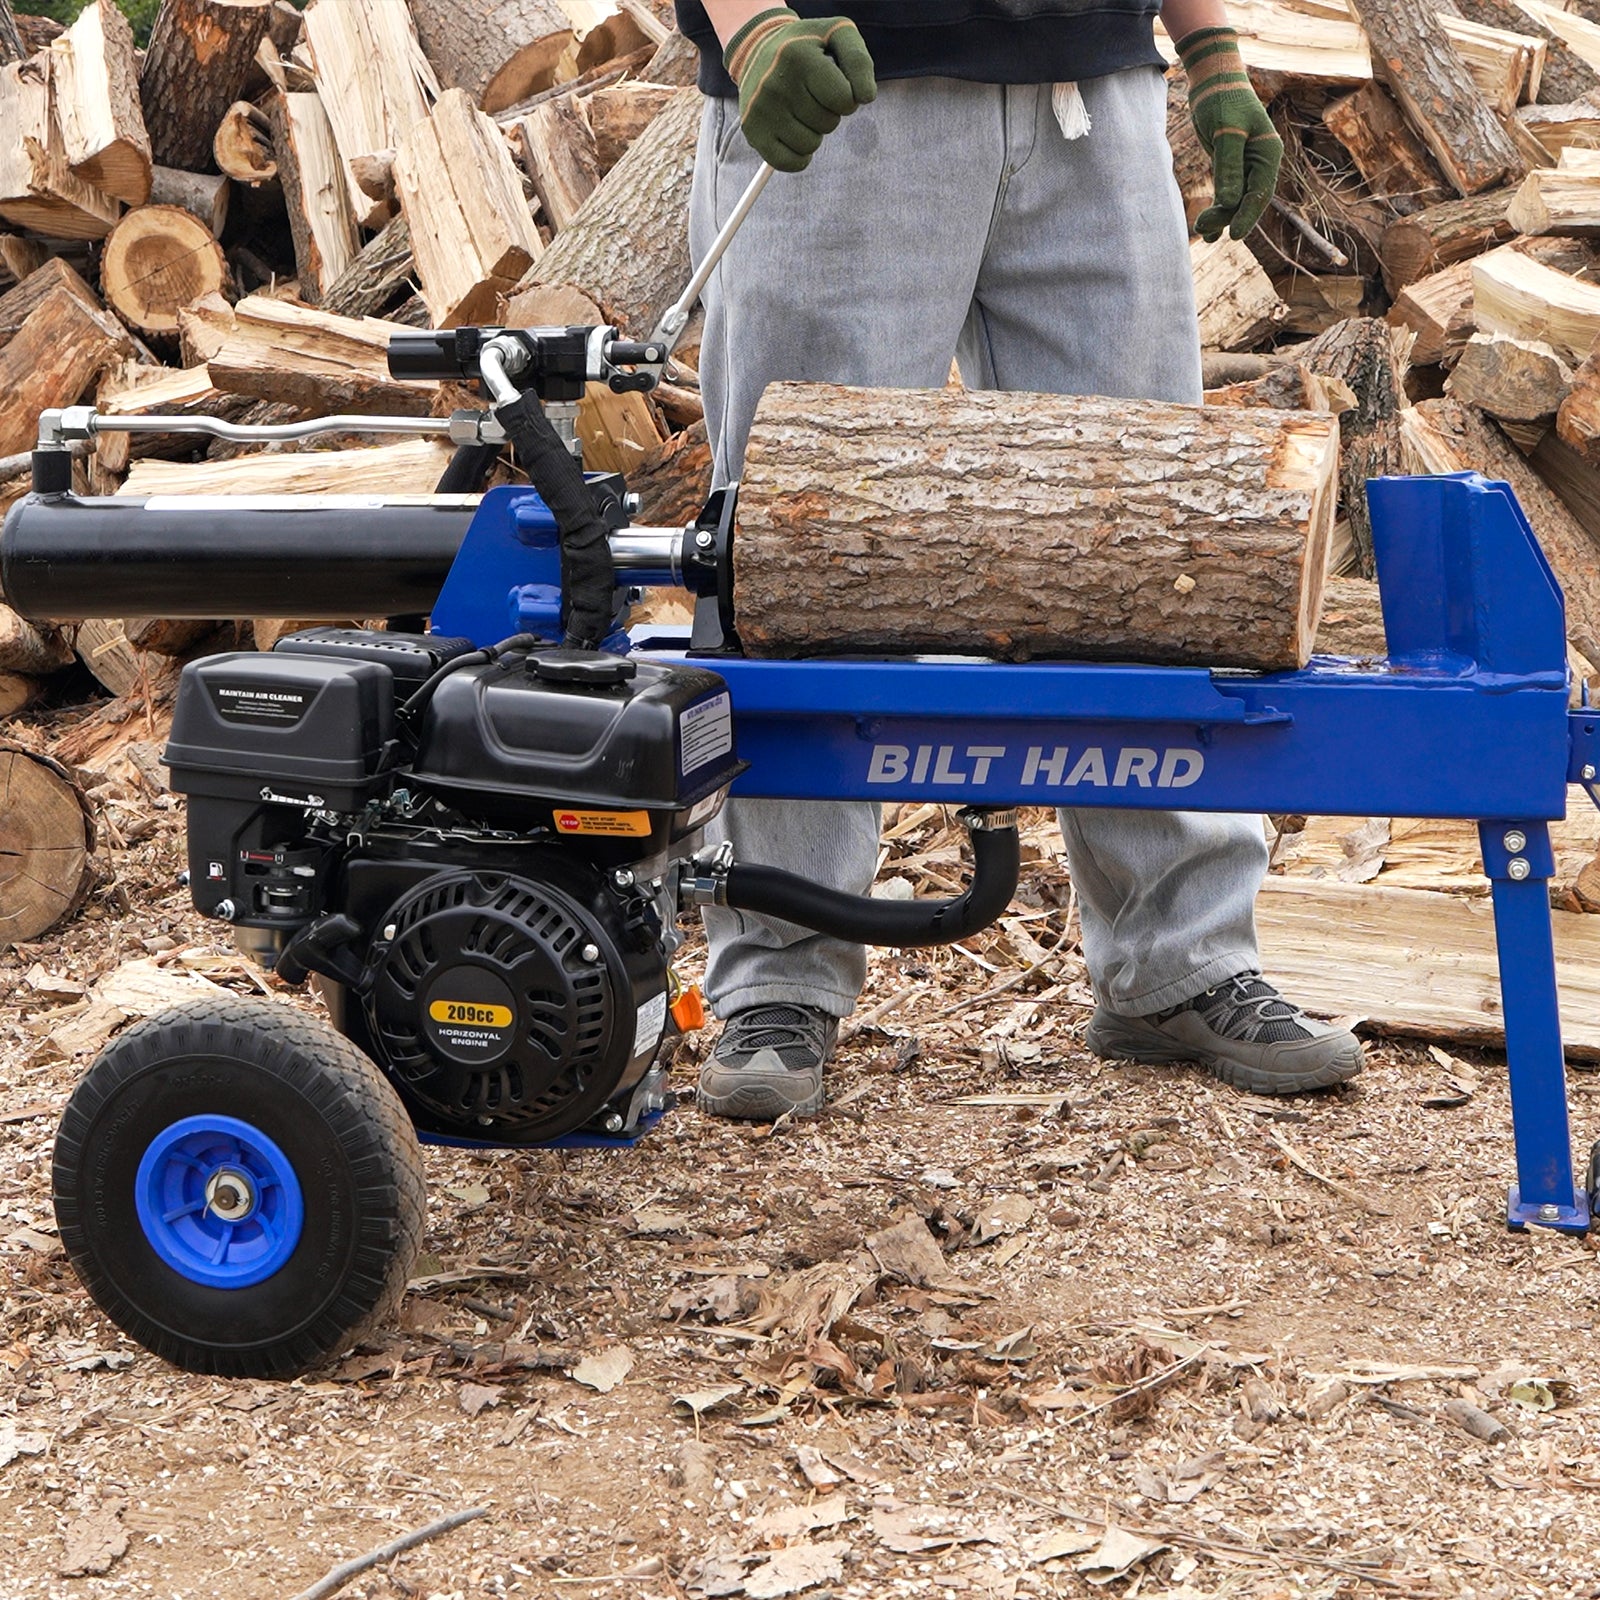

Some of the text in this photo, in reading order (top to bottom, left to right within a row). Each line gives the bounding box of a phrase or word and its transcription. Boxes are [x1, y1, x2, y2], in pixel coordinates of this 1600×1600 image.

[219, 689, 254, 698] MAINTAIN
[269, 693, 303, 702] CLEANER
[867, 745, 1205, 788] BILT HARD
[447, 1004, 495, 1024] 209cc
[438, 1028, 501, 1041] HORIZONTAL
[451, 1038, 488, 1048] ENGINE
